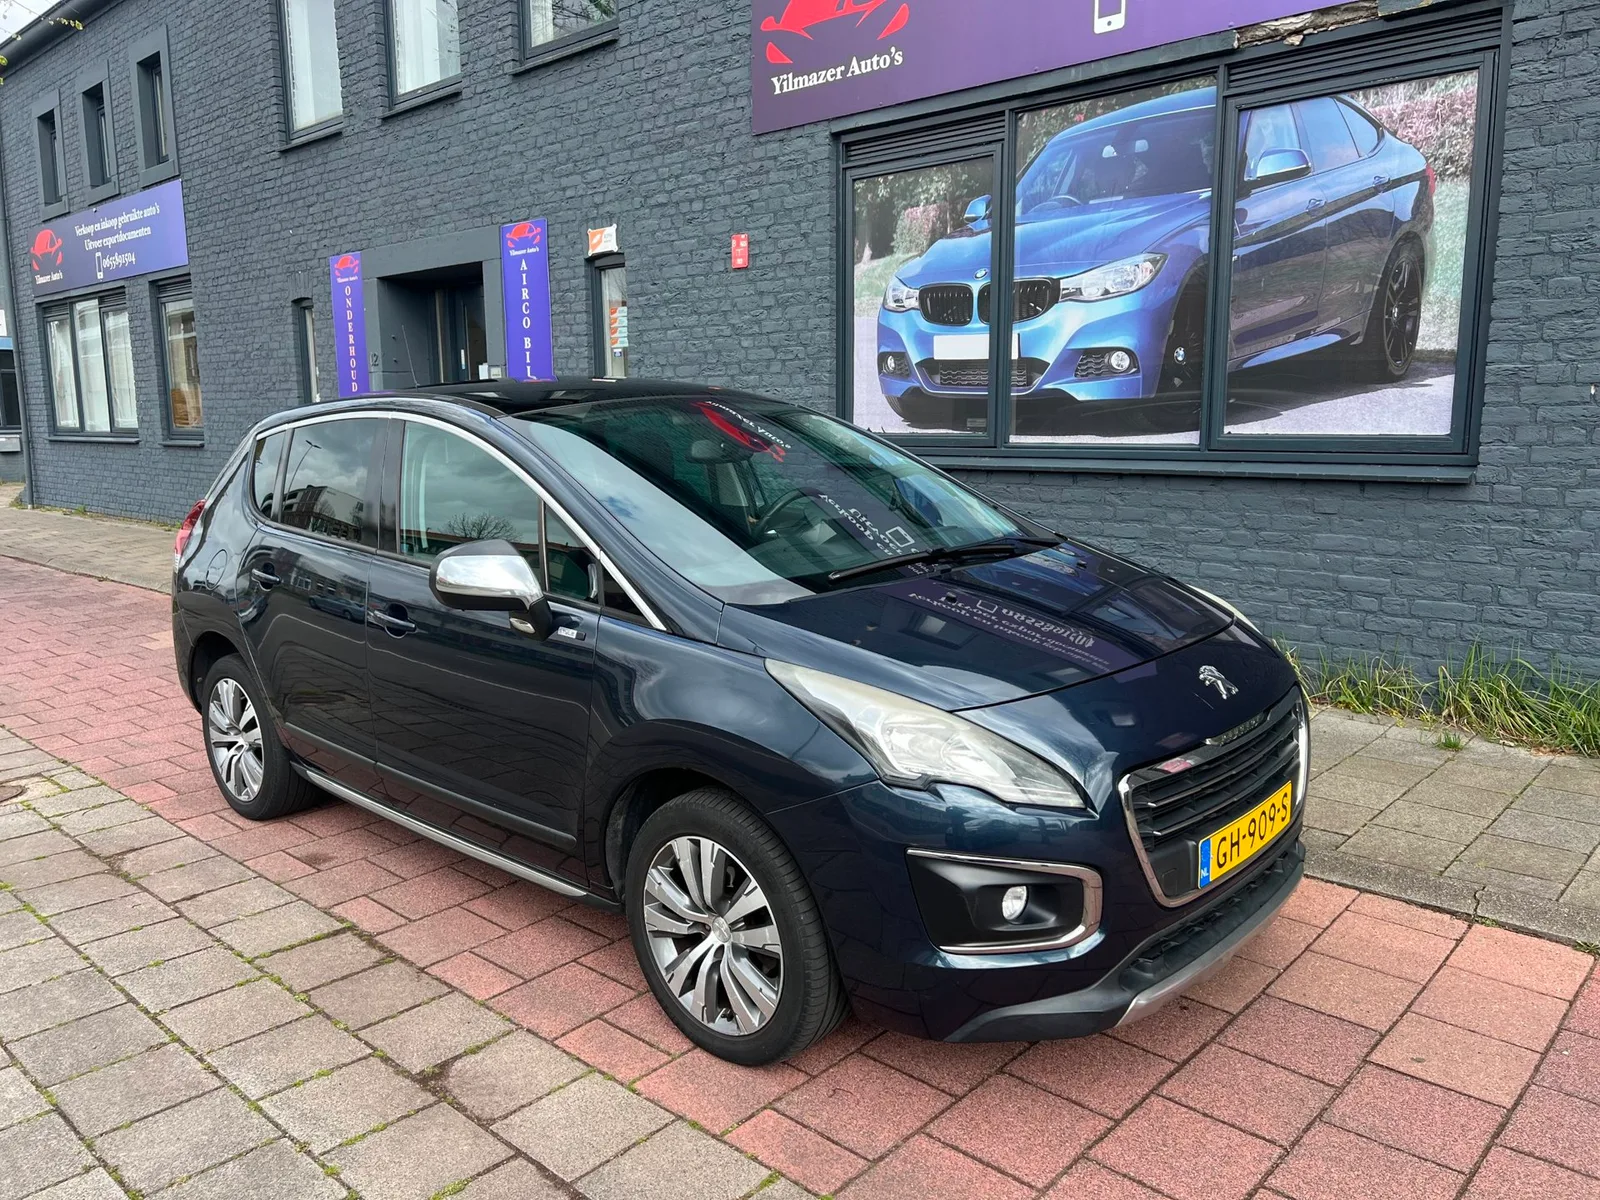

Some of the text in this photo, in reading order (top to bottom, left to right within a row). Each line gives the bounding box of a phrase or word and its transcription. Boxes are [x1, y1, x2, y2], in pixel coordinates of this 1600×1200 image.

[770, 46, 903, 95] Yilmazer Auto's
[74, 224, 94, 236] Verkoop
[101, 217, 118, 230] inkoop
[117, 208, 144, 229] gebruikte
[84, 226, 152, 251] Uitvoer exportdocumenten
[520, 258, 531, 329] AIRCO
[344, 285, 358, 392] ONDERHOUD
[1216, 792, 1288, 869] GH-909-S
[1200, 867, 1209, 879] NL
